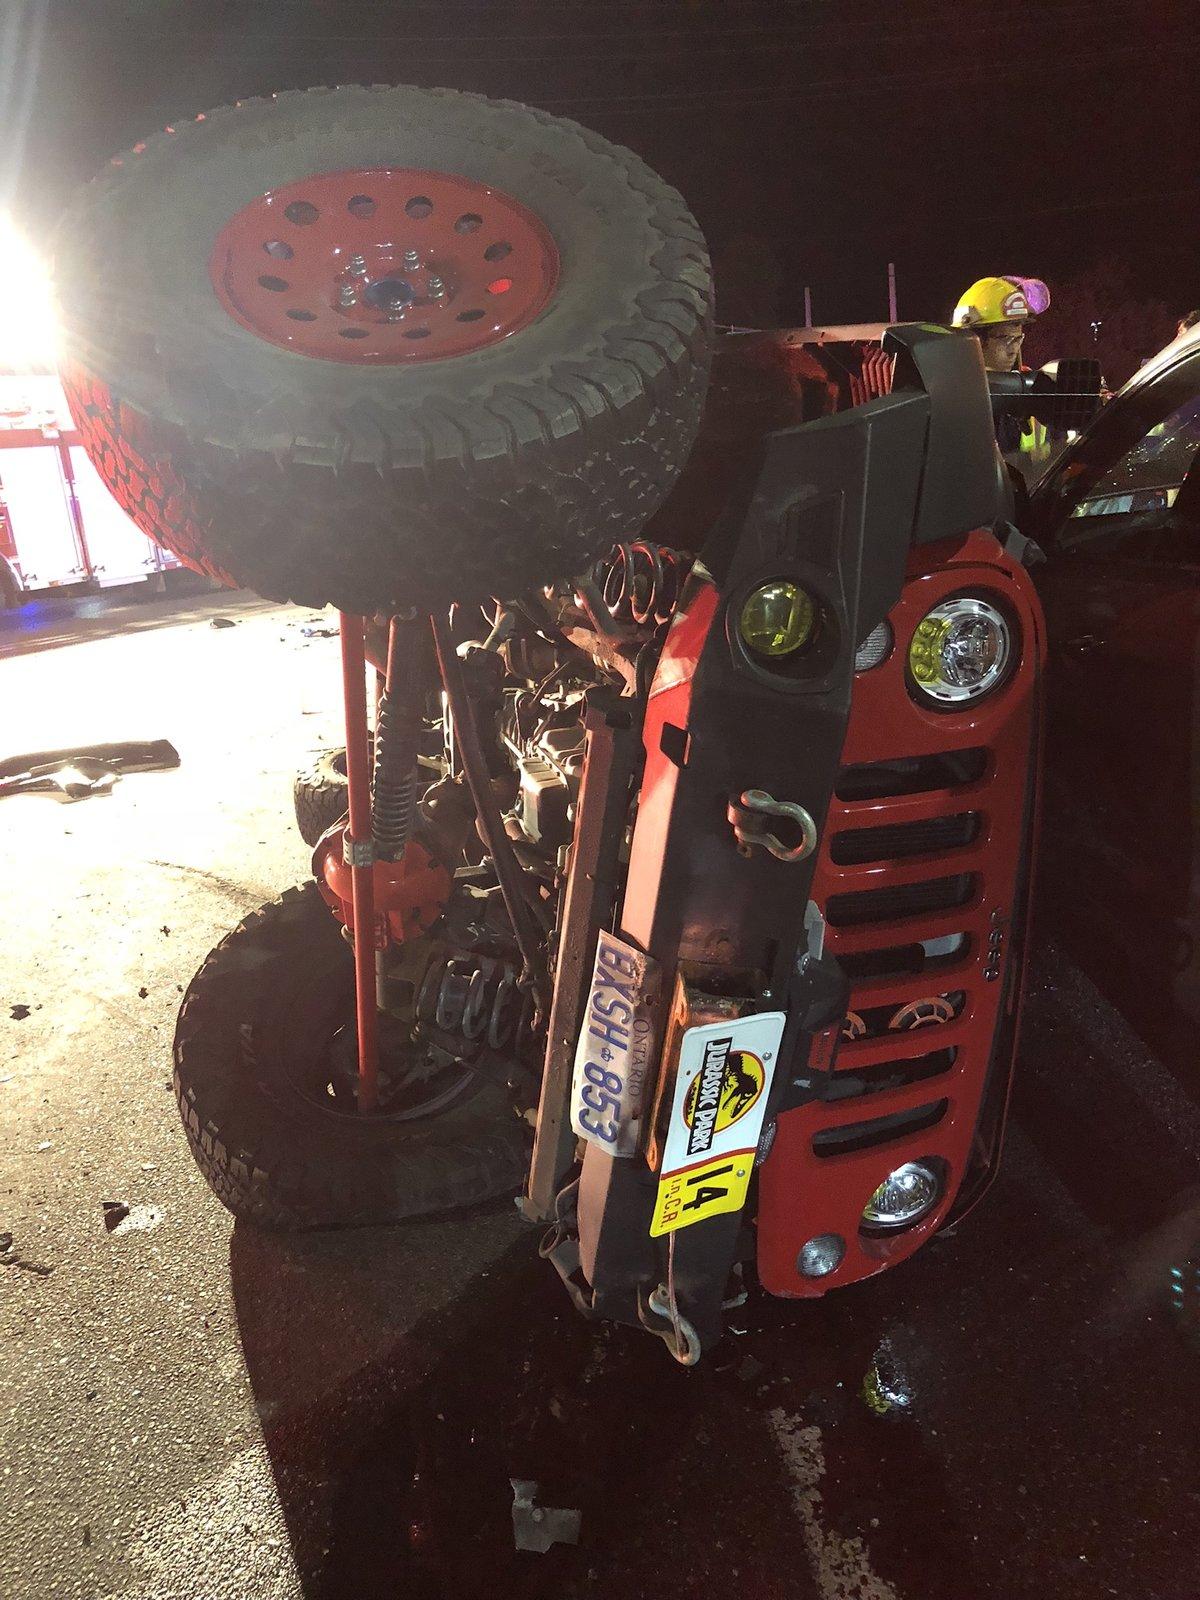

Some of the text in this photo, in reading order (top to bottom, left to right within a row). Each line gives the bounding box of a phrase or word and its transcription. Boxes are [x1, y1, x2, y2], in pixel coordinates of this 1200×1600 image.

[579, 945, 637, 1144] BXSH 853
[690, 1040, 730, 1153] JURASSIC PARK
[683, 1163, 734, 1211] 14
